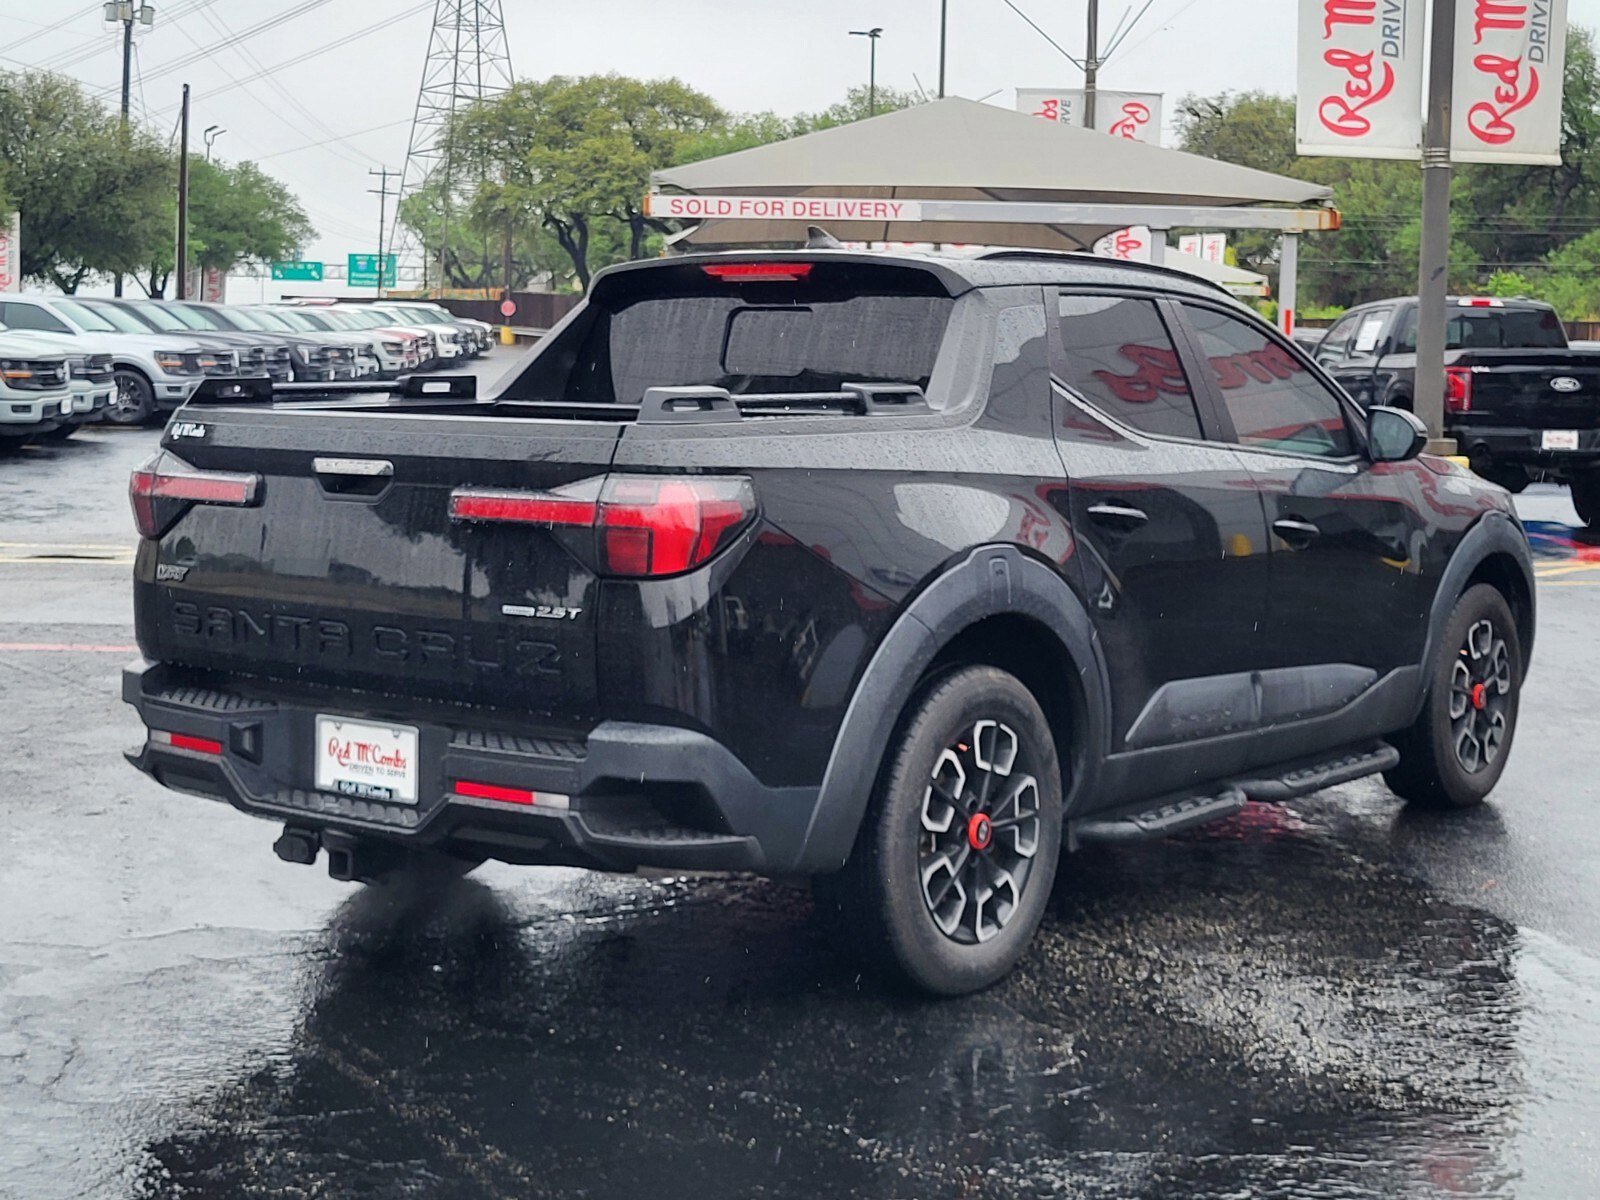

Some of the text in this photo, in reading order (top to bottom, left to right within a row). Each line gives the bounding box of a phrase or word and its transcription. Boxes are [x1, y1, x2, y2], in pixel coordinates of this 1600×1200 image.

[1318, 48, 1395, 138] Red
[1467, 54, 1539, 145] Red
[670, 198, 904, 219] SOLD FOR DELIVERY
[173, 601, 563, 675] SANTA CRUZ
[328, 736, 406, 769] Red McCombs
[376, 766, 385, 775] TO
